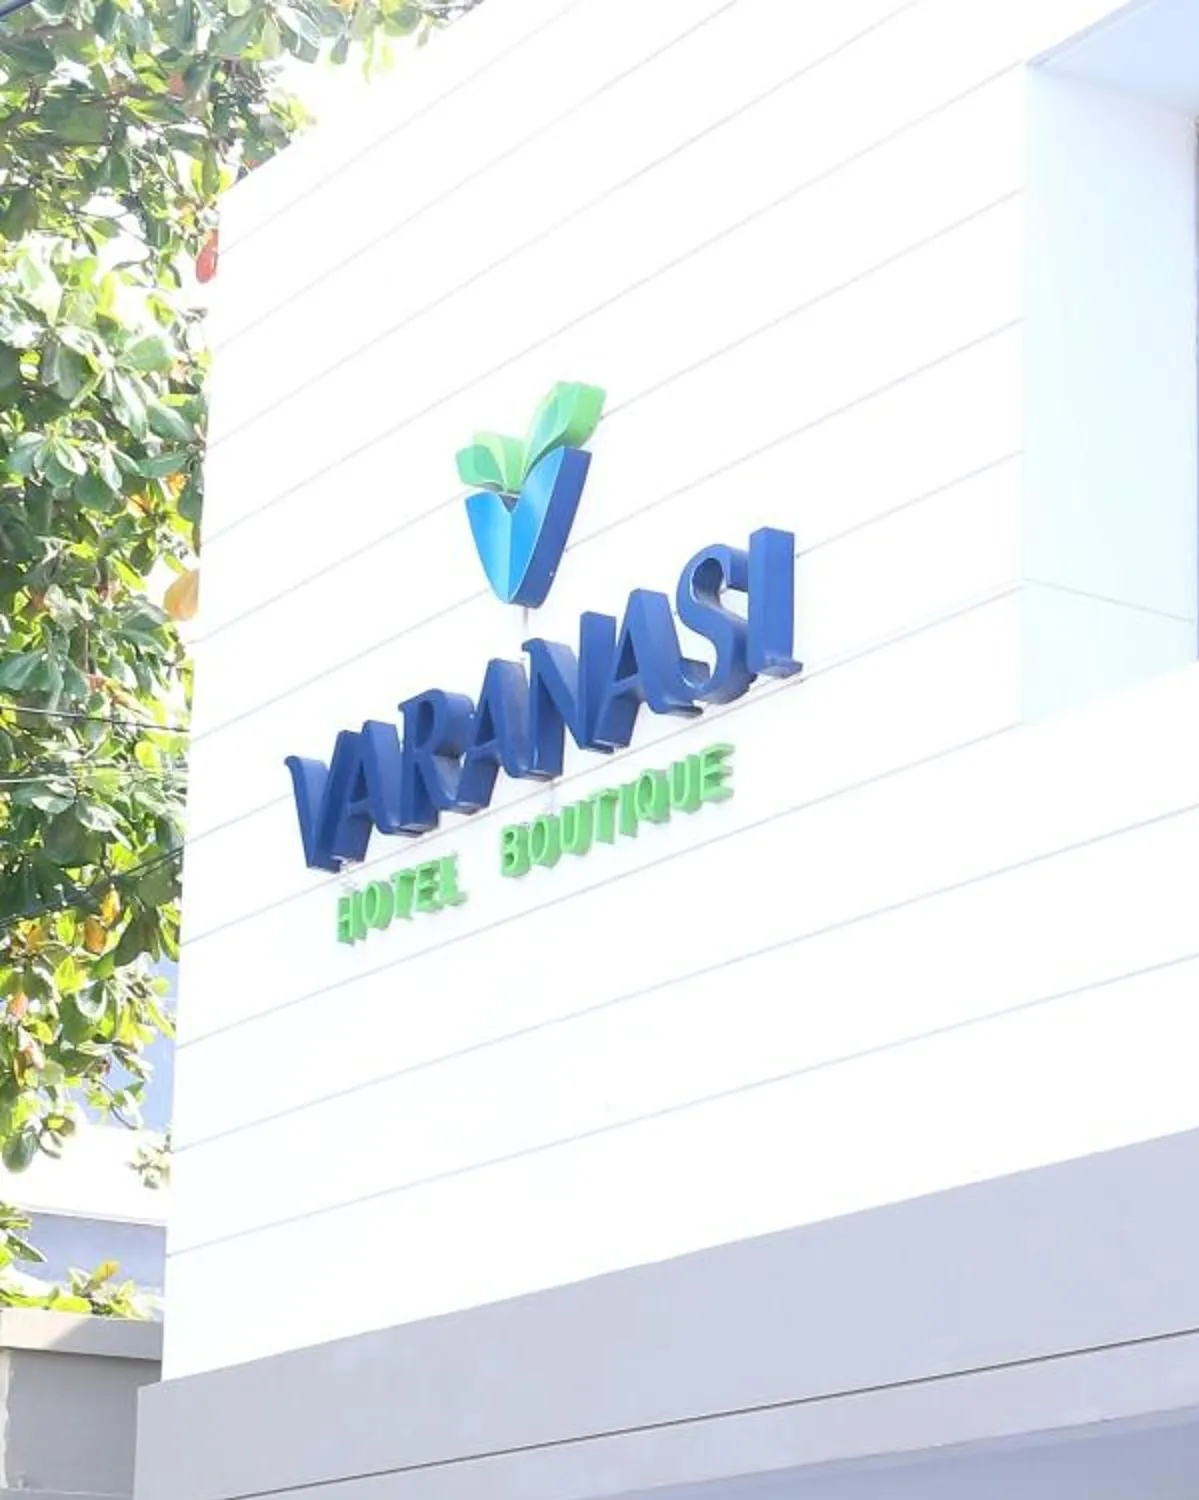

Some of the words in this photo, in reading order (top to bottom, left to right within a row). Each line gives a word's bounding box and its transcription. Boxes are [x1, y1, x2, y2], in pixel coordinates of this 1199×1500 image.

[284, 526, 803, 873] VARANASI
[337, 852, 467, 946] HOTEL
[499, 742, 735, 878] BOUTIQUE
